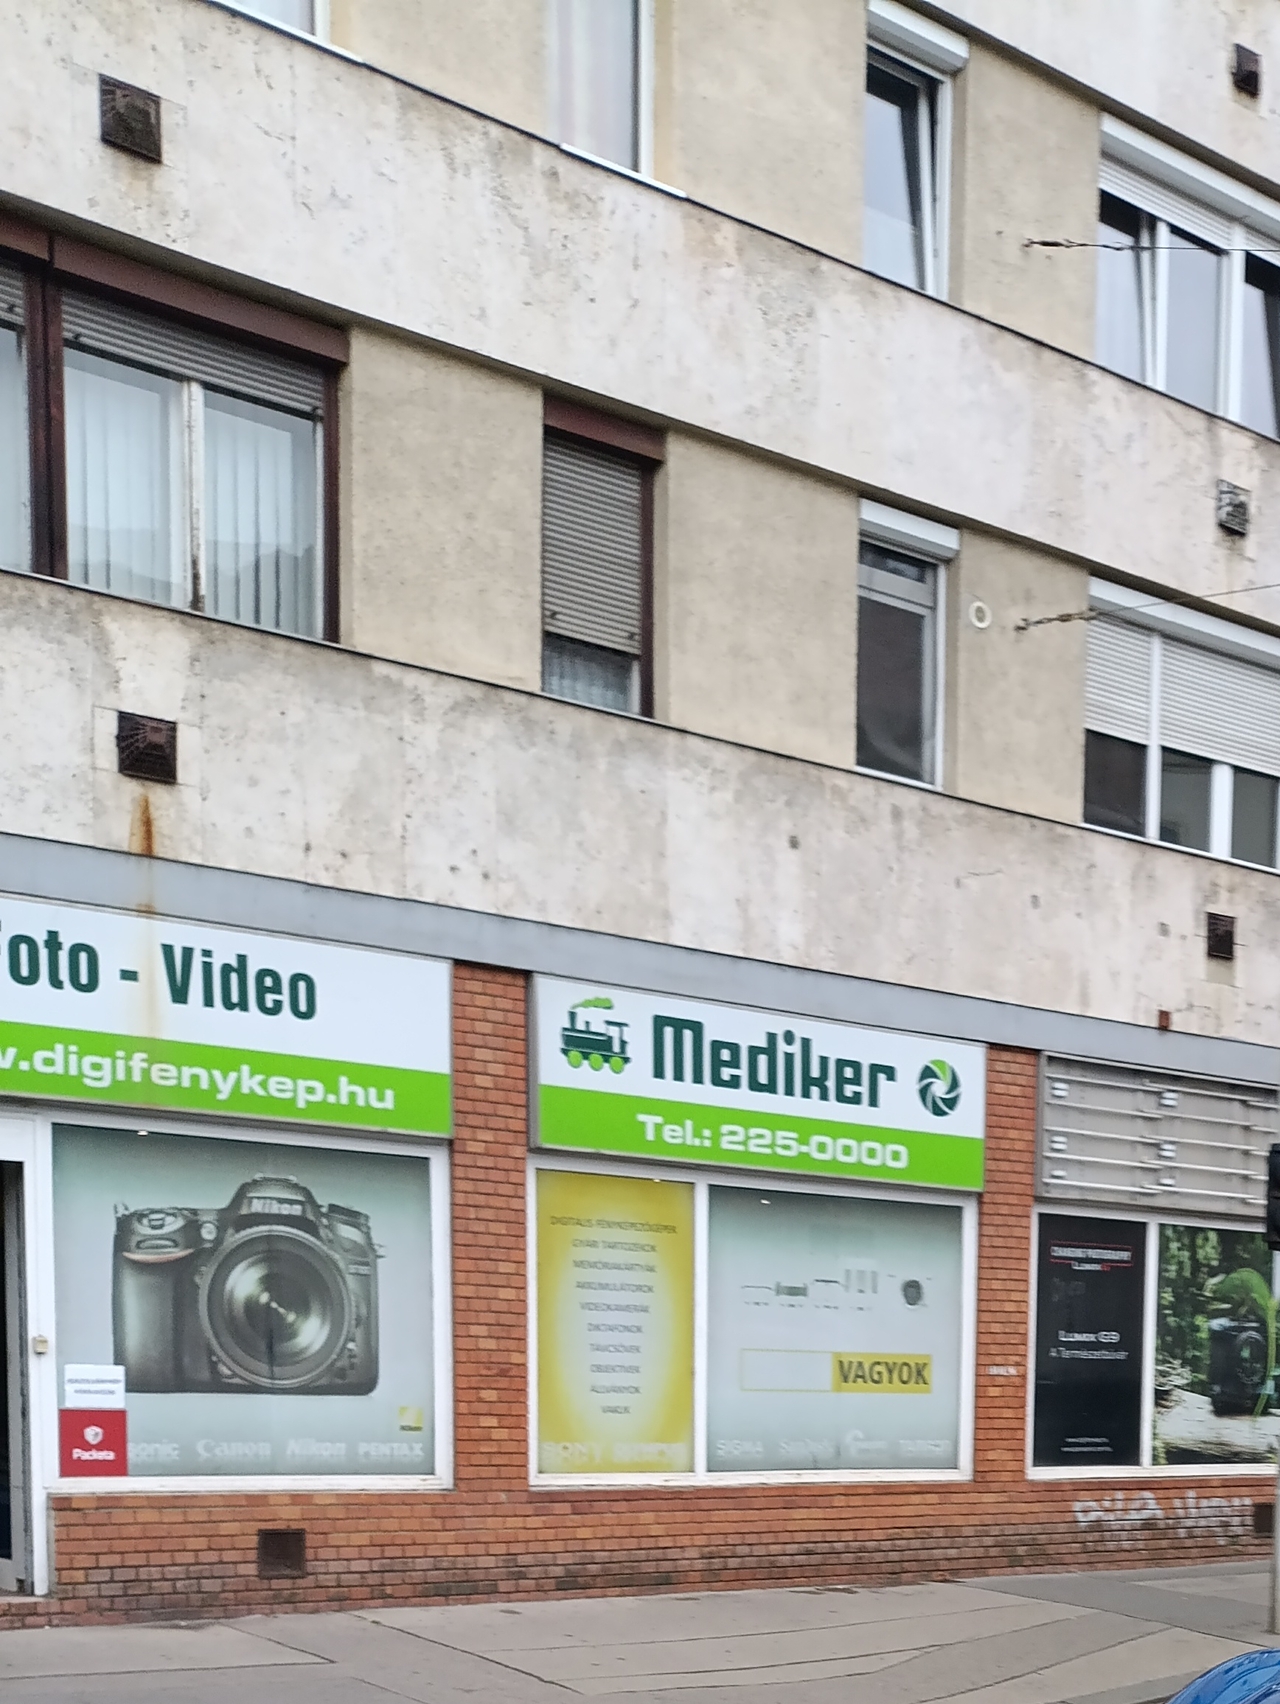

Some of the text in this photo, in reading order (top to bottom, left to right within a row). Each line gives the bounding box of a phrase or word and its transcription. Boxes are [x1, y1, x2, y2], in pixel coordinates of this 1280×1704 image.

[0, 928, 100, 994] oto
[161, 942, 317, 1021] Video
[652, 1014, 896, 1109] Mediker
[636, 1113, 908, 1170] Tel.: 225-0000
[838, 1360, 929, 1386] VAGYOK
[196, 1438, 271, 1458] Canon
[286, 1437, 347, 1457] Nikon
[358, 1441, 424, 1457] PENTAX
